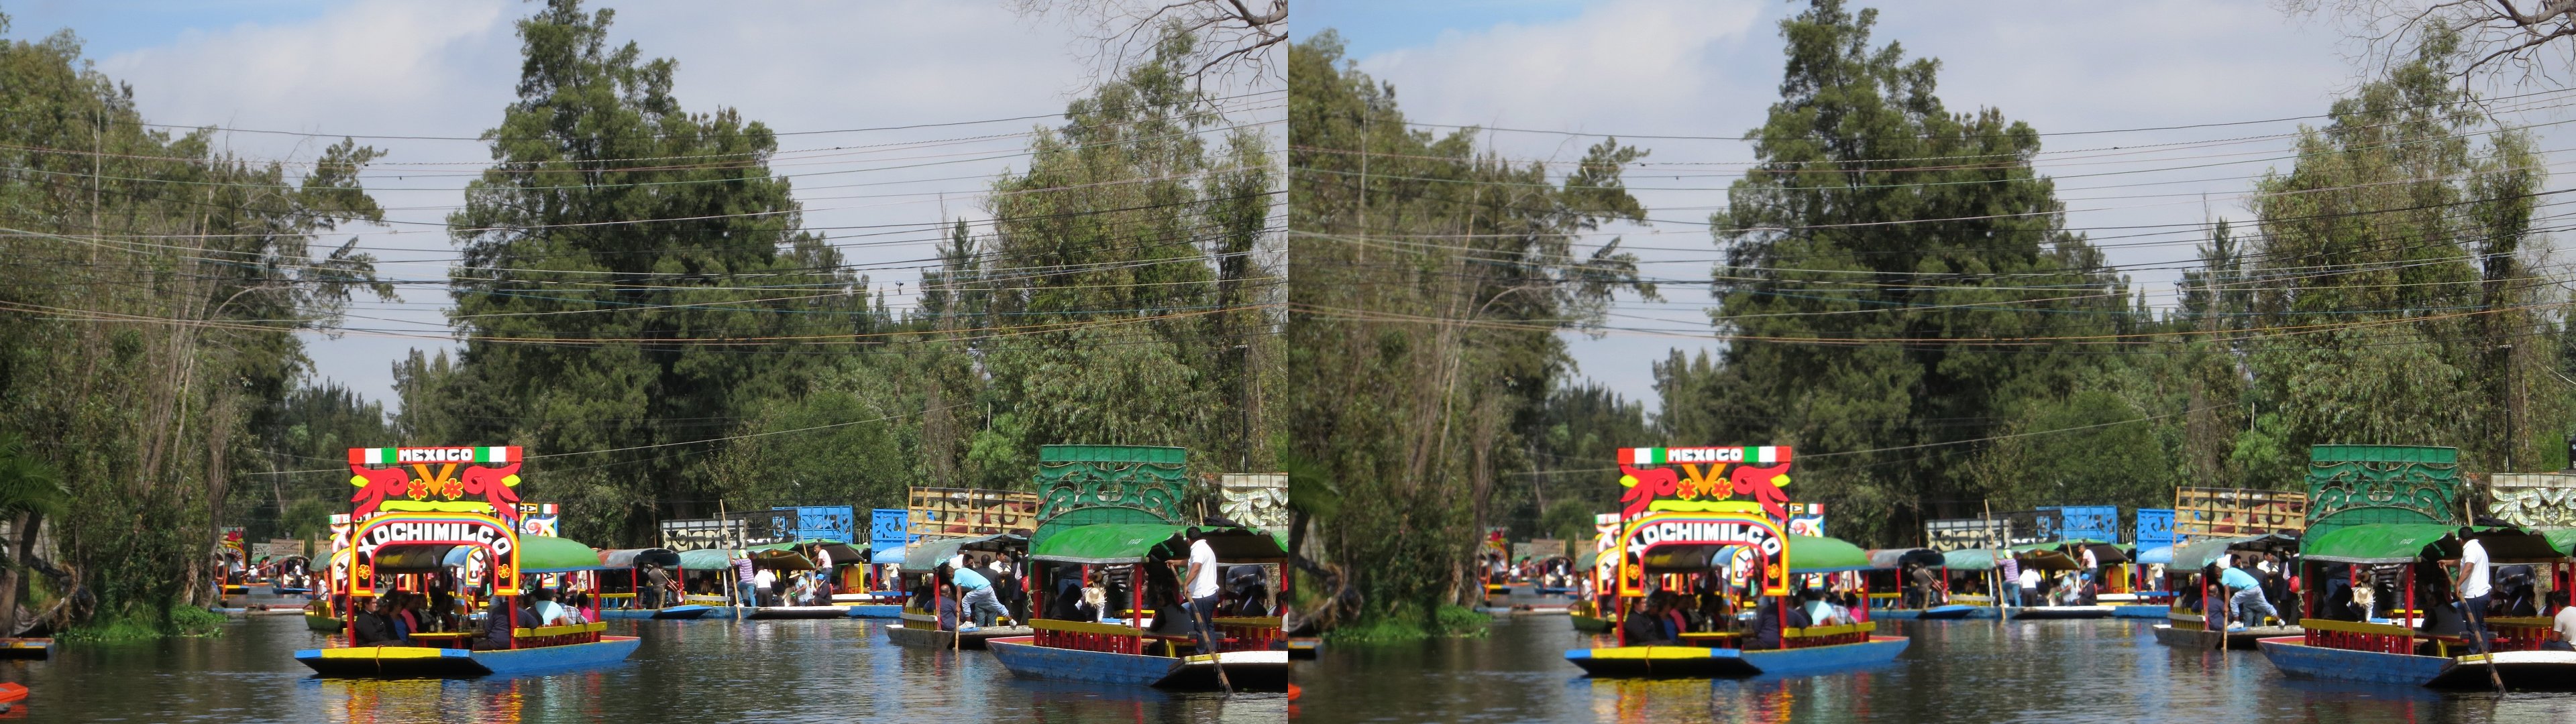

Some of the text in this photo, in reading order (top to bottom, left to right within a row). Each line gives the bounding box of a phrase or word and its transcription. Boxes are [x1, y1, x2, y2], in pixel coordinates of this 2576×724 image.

[398, 448, 473, 462] MEXICO
[1668, 448, 1743, 461] MEXICO
[357, 523, 512, 558] XOCHIMILCO
[1626, 522, 1782, 558] XOCHIMILCO
